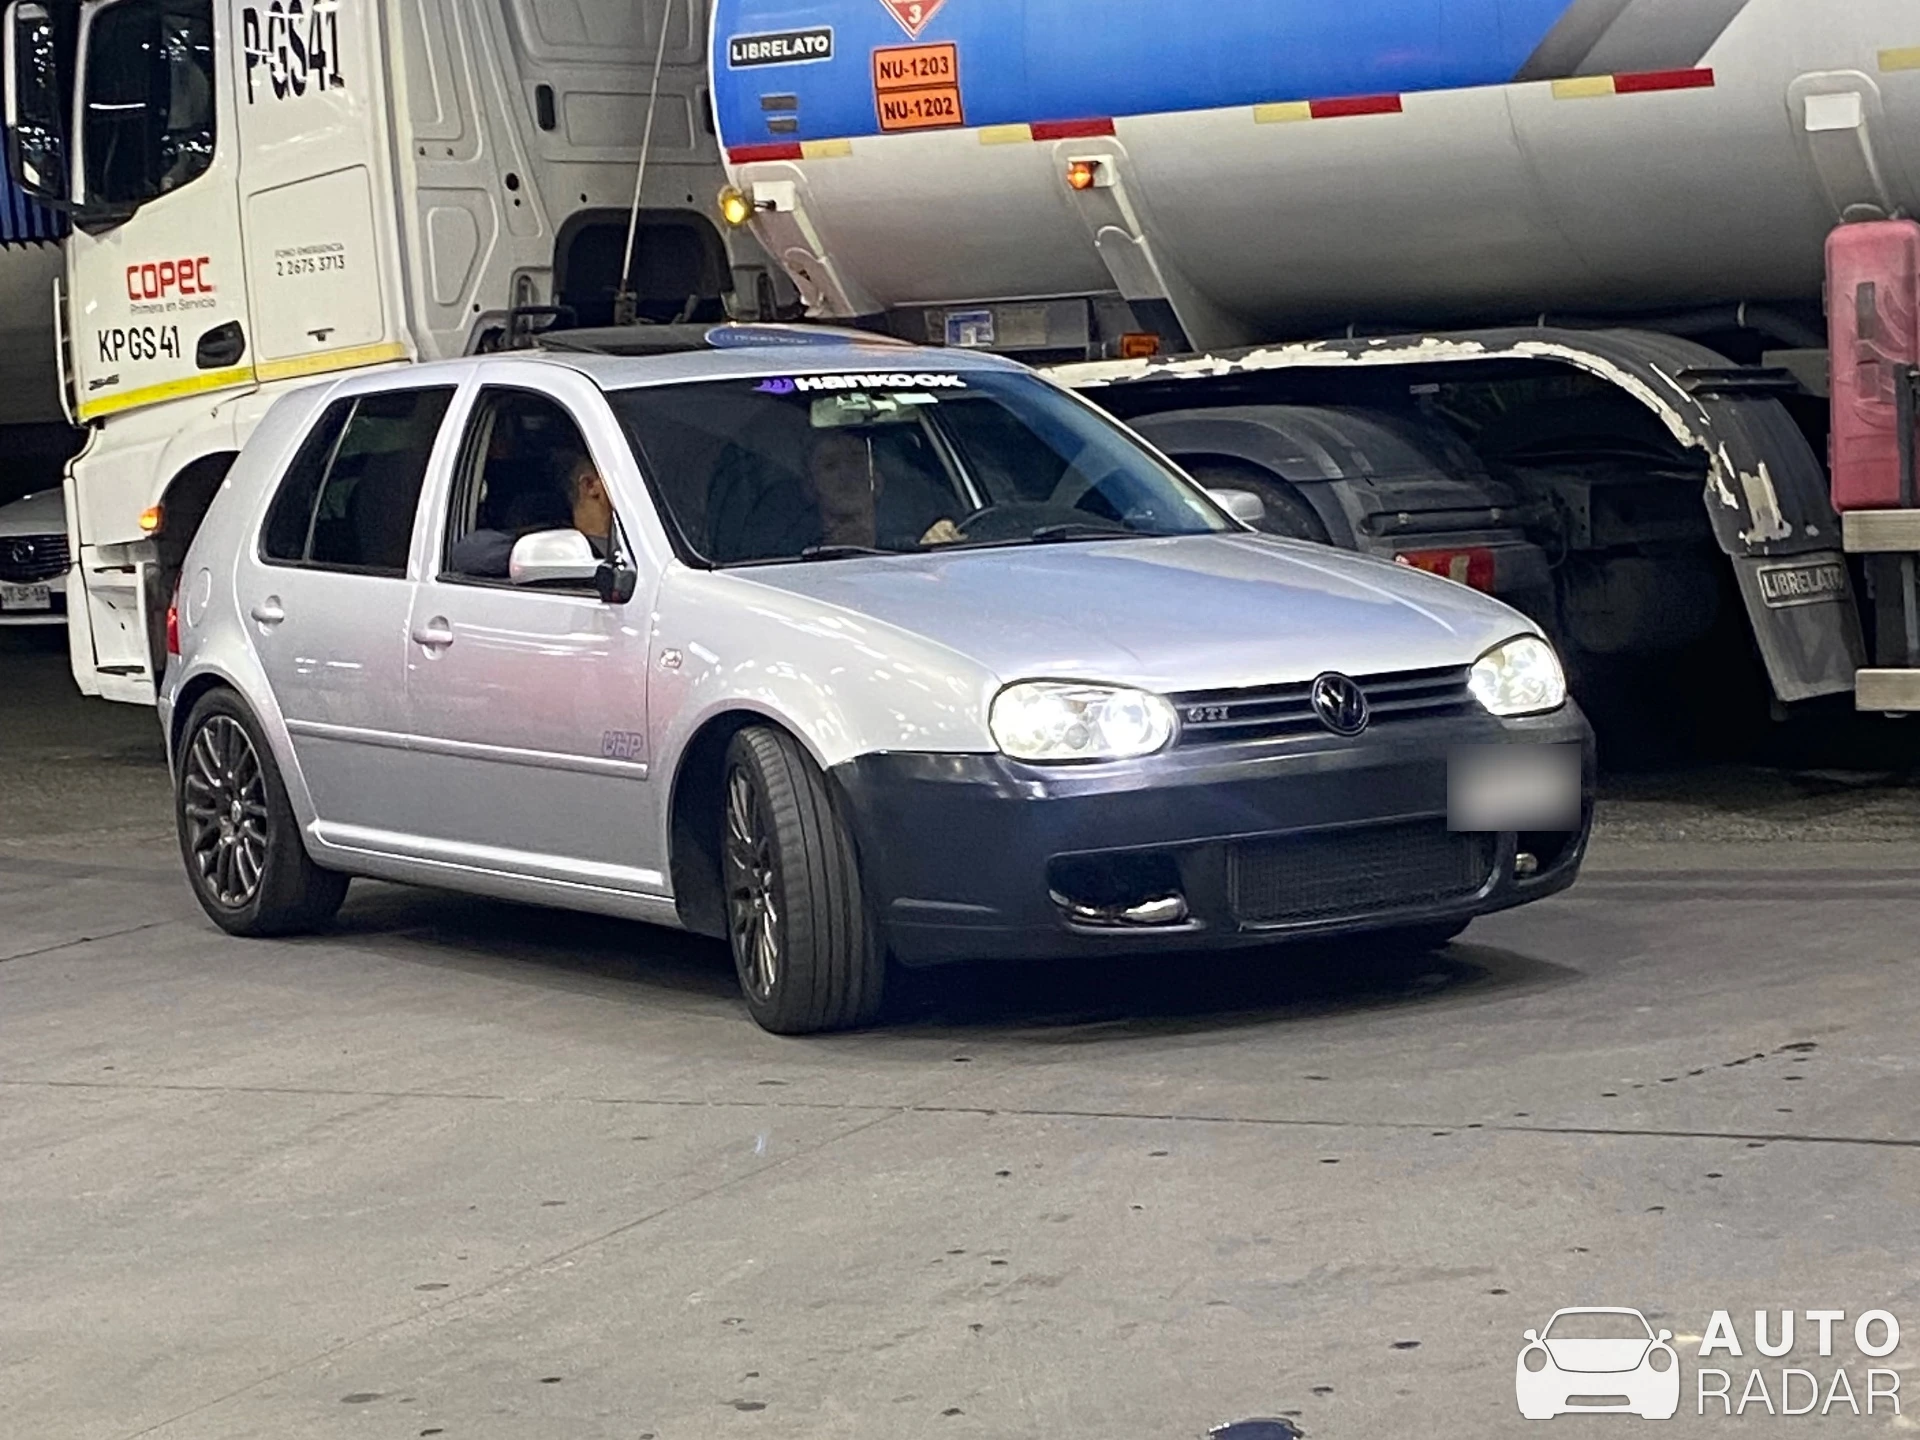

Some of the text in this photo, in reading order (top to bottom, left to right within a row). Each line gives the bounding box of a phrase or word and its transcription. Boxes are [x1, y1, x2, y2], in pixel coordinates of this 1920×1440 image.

[908, 4, 921, 23] 3
[731, 35, 829, 61] LIBRELATO
[879, 56, 949, 79] NU-1203
[884, 97, 955, 120] NU-1202
[276, 254, 345, 276] 2 2675 3713
[98, 325, 180, 362] KPGS41
[1187, 706, 1229, 722] GTI
